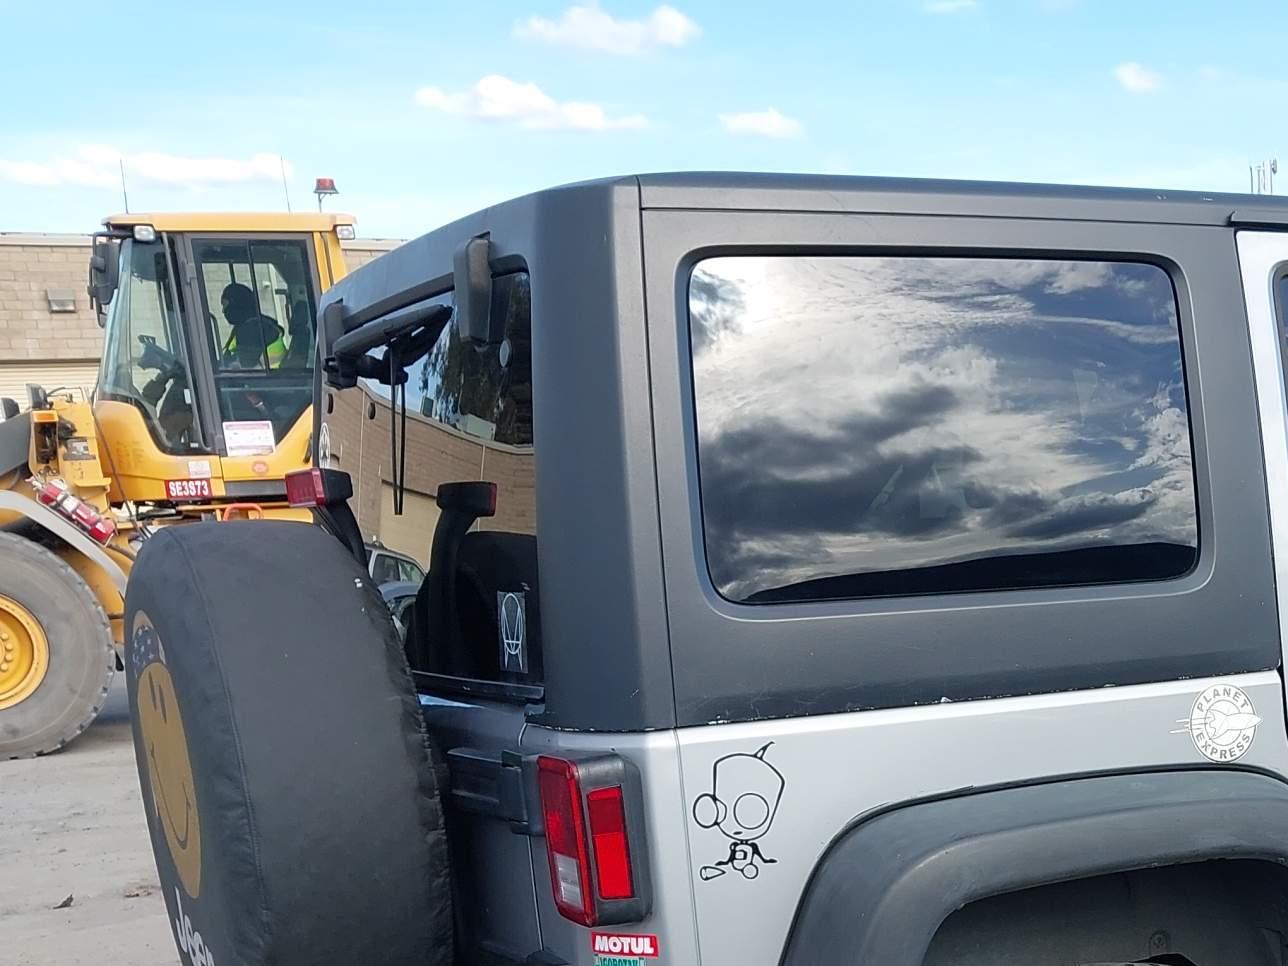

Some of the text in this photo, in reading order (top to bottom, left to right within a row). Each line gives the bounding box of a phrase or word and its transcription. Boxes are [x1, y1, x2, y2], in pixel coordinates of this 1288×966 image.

[1196, 687, 1249, 712] PLANET
[1196, 732, 1250, 759] EXPRESS
[595, 935, 635, 954] MOTUL
